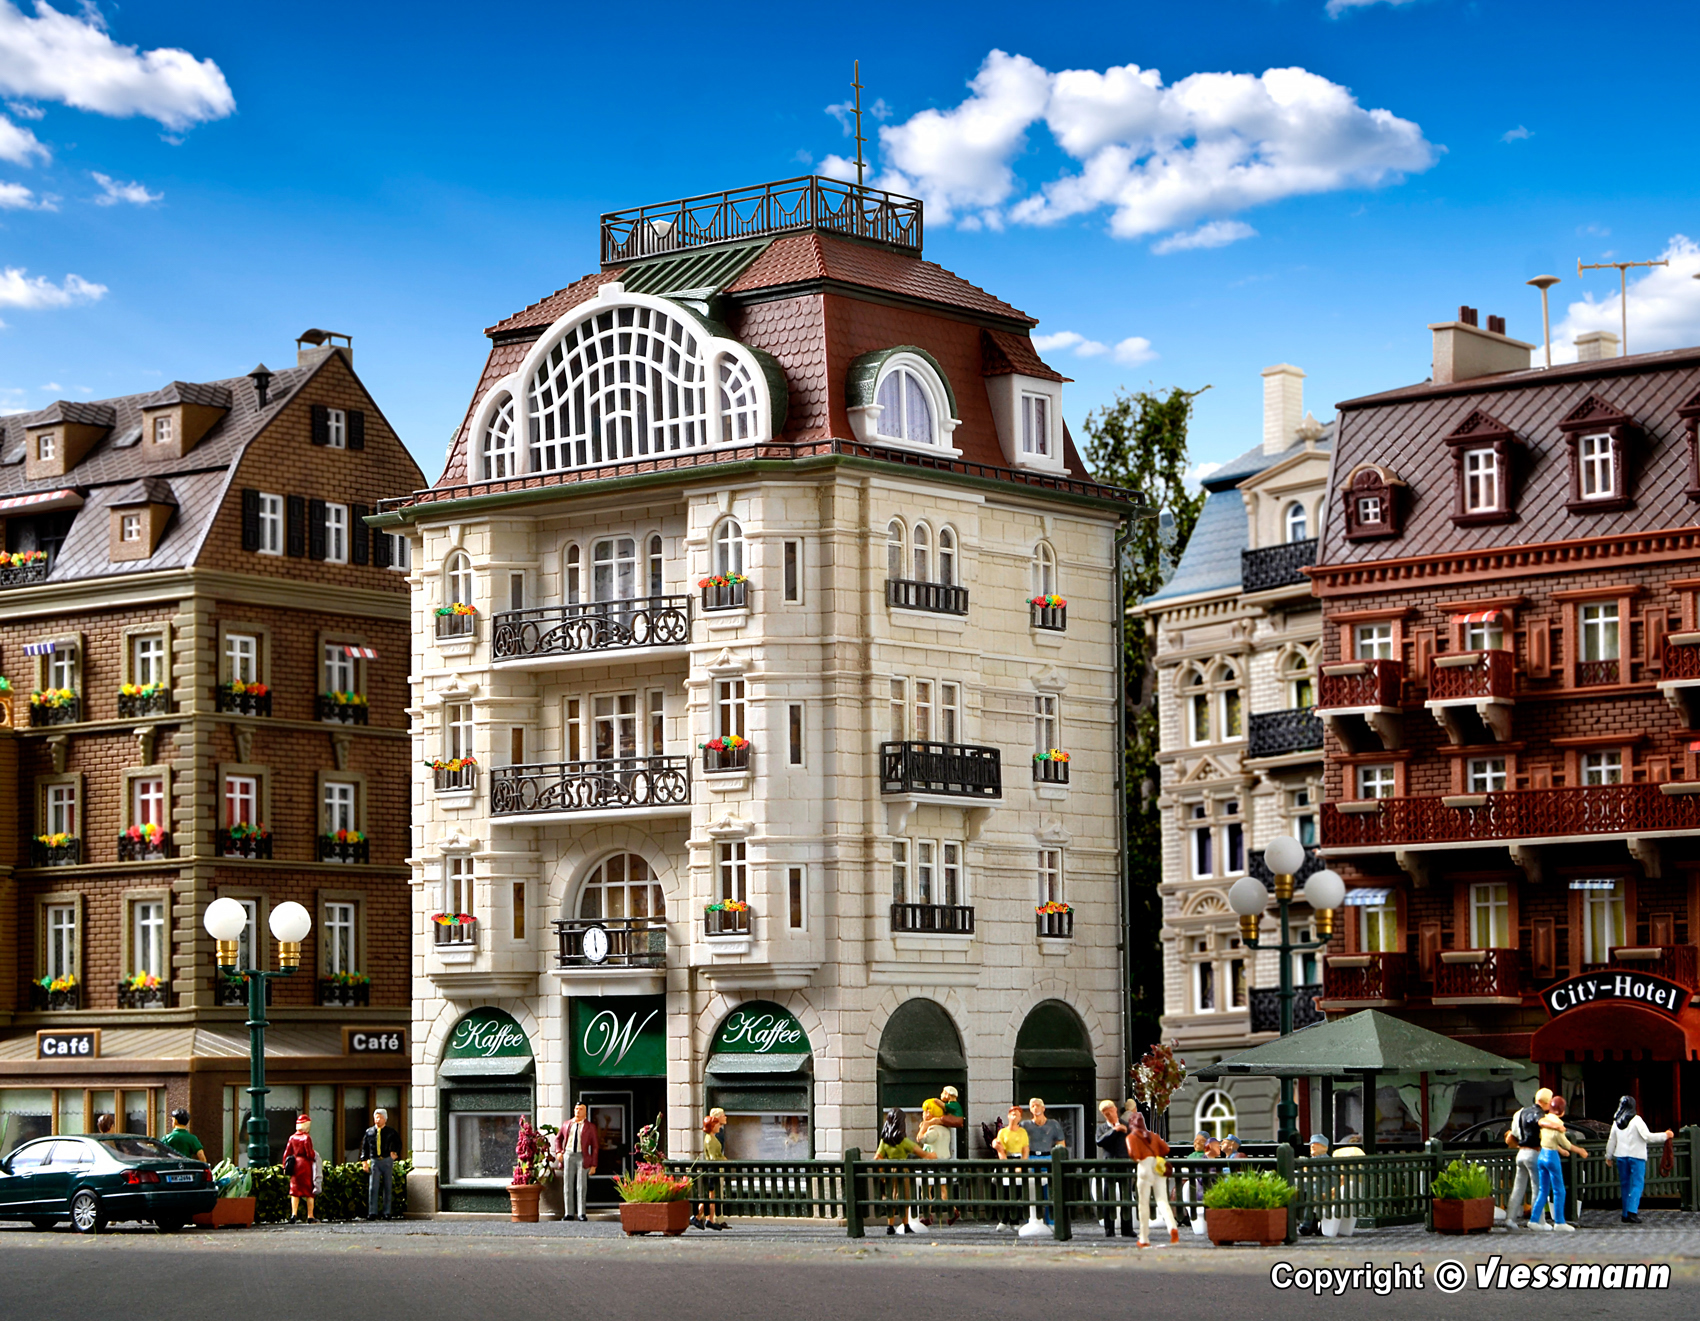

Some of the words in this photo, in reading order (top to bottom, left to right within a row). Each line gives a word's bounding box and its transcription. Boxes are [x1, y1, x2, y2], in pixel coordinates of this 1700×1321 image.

[1551, 975, 1677, 1011] City-Hotel
[43, 1037, 89, 1054] Café
[353, 1033, 399, 1050] Café
[452, 1019, 523, 1057] Kaffee
[583, 1010, 658, 1067] W
[722, 1012, 801, 1052] Kaffee
